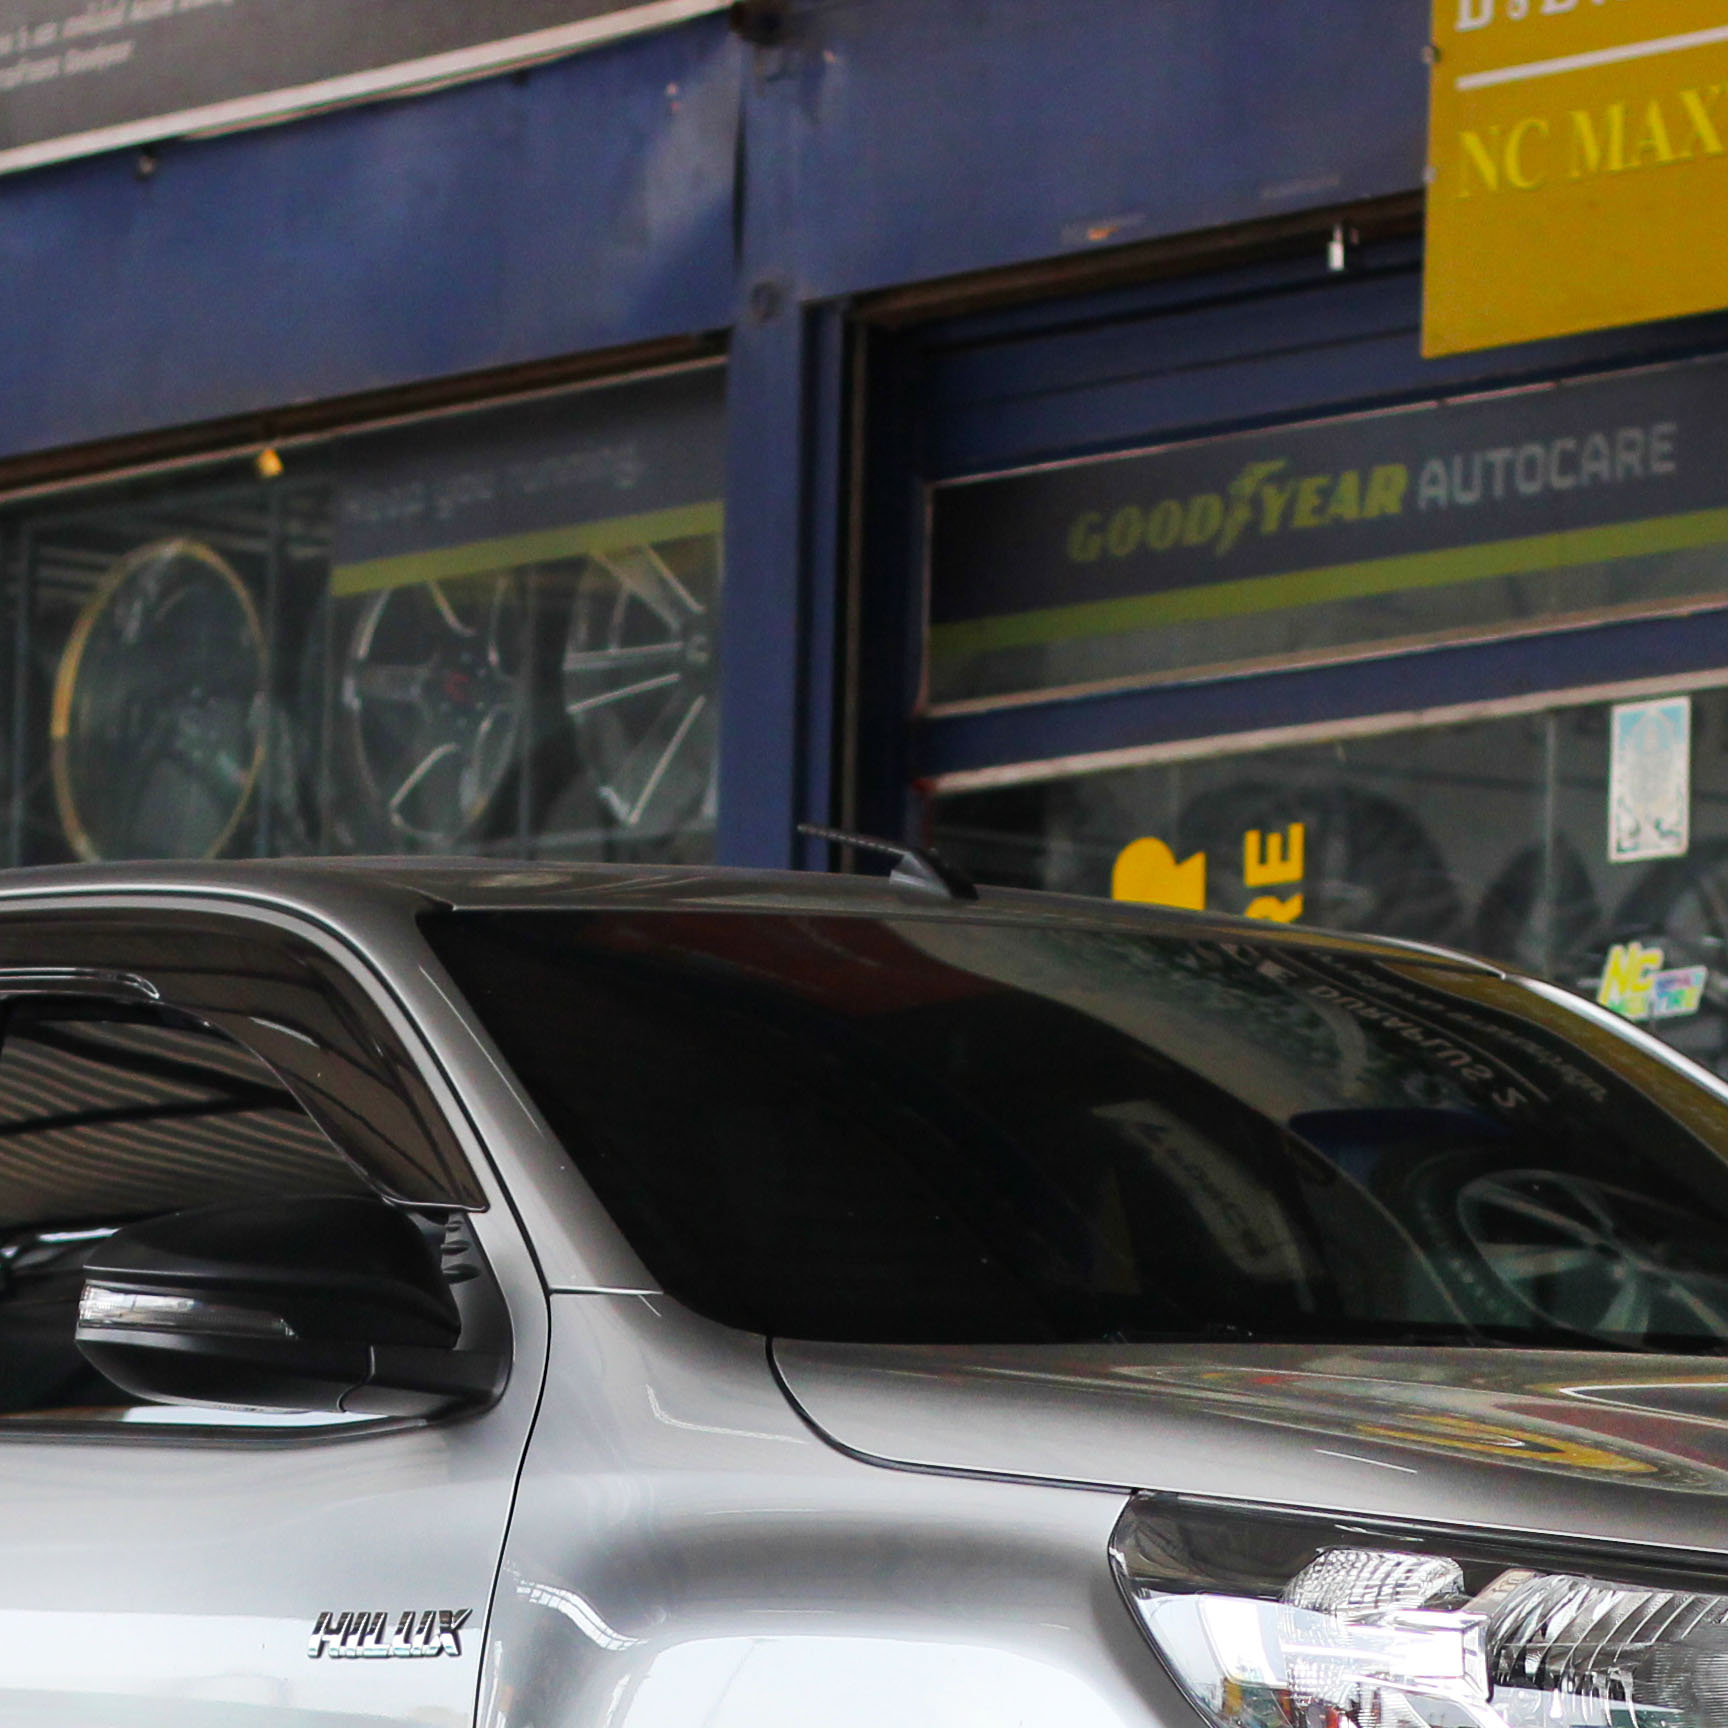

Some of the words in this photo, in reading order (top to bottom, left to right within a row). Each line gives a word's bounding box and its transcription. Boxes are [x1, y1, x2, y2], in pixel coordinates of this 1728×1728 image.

[1456, 117, 1550, 199] NC
[1067, 456, 1409, 563] GOODYEAR
[1417, 422, 1678, 512] AUTOCARE
[307, 1608, 473, 1658] HILUX
